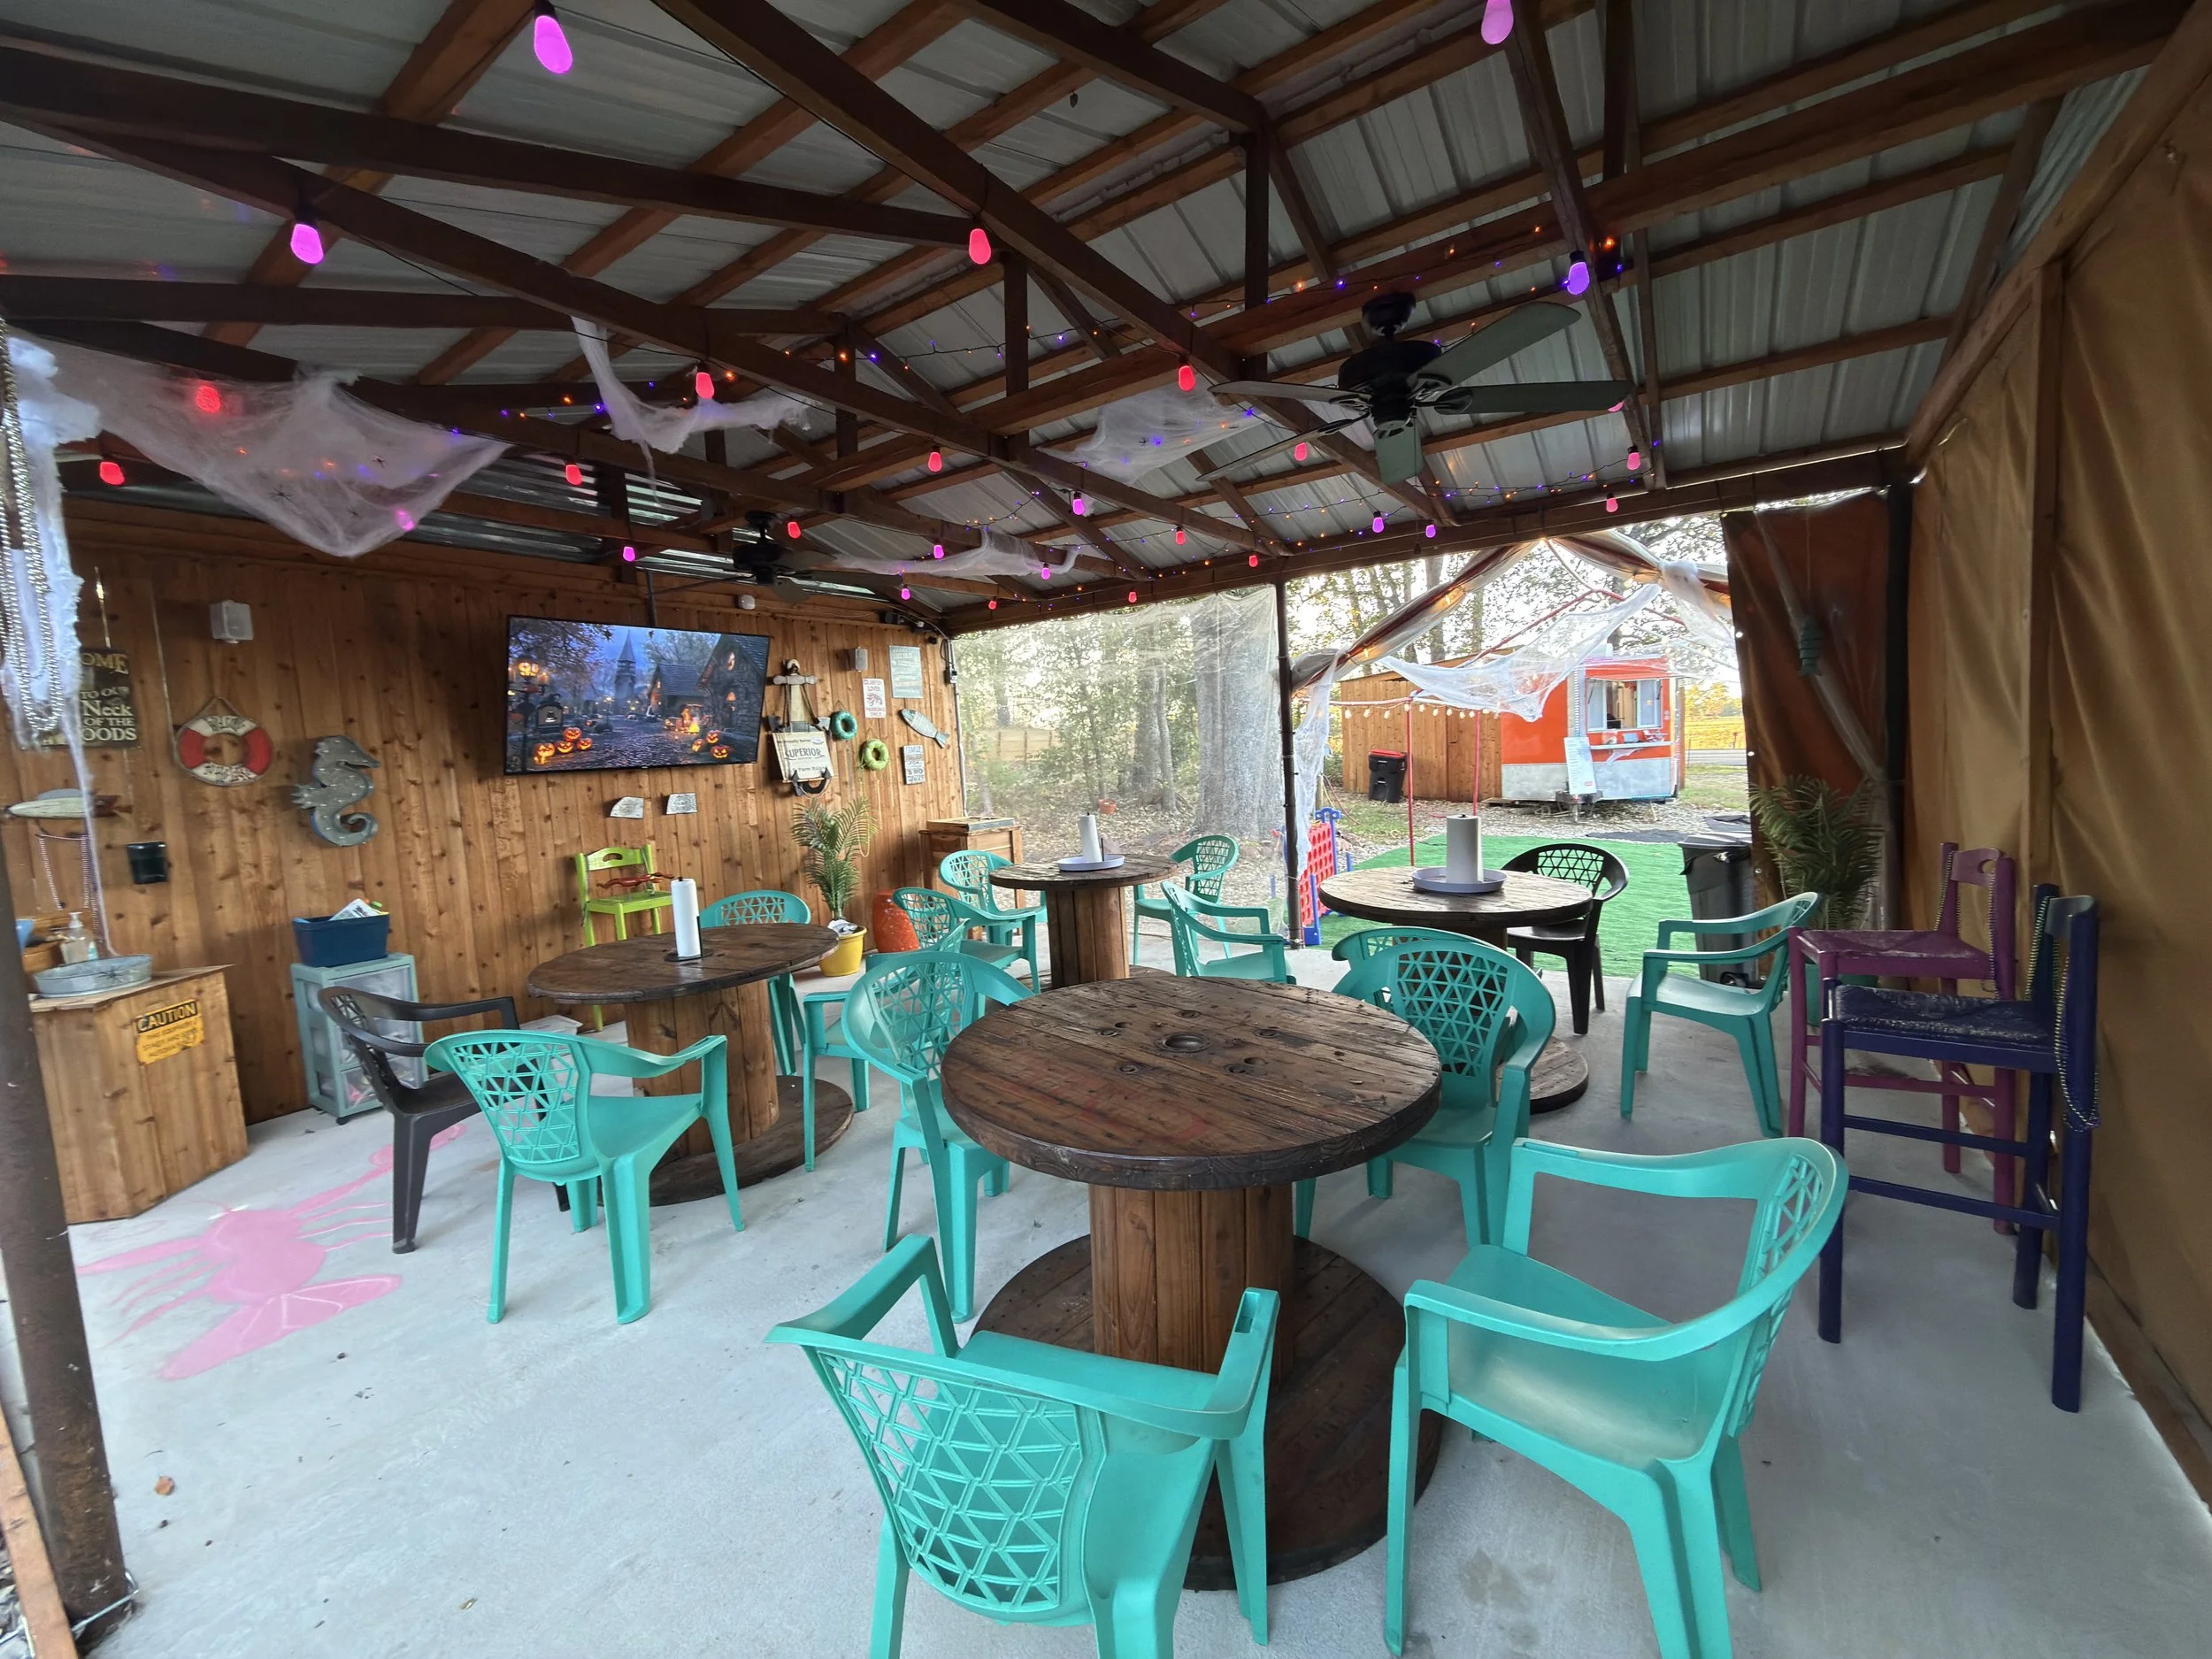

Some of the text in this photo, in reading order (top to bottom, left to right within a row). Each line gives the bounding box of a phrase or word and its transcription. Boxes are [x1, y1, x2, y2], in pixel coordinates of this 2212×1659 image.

[81, 700, 134, 716] Neck
[84, 718, 135, 726] OF THE
[81, 727, 137, 741] OODS
[137, 1002, 196, 1032] CAUTION
